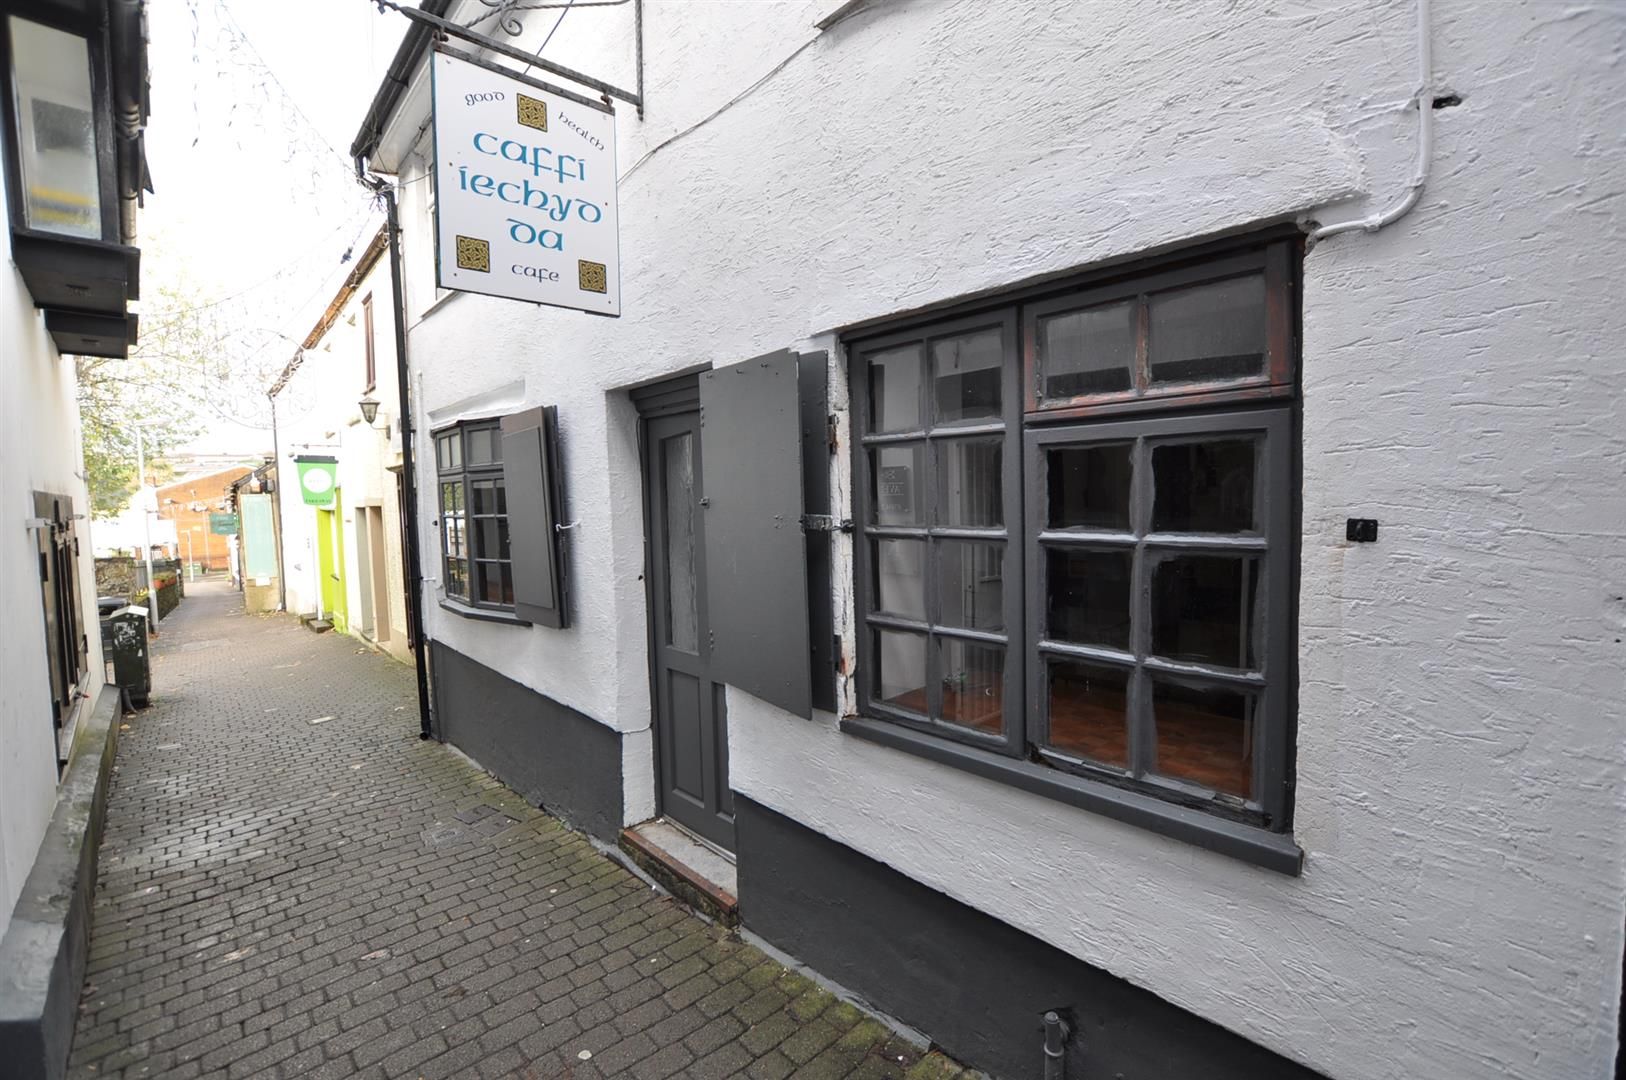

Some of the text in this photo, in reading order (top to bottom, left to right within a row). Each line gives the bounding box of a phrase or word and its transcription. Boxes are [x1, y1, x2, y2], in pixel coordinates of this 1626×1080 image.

[464, 91, 605, 152] good health
[472, 132, 586, 184] caffi
[458, 165, 602, 223] iechyd
[505, 218, 564, 251] da
[511, 262, 560, 283] cafe
